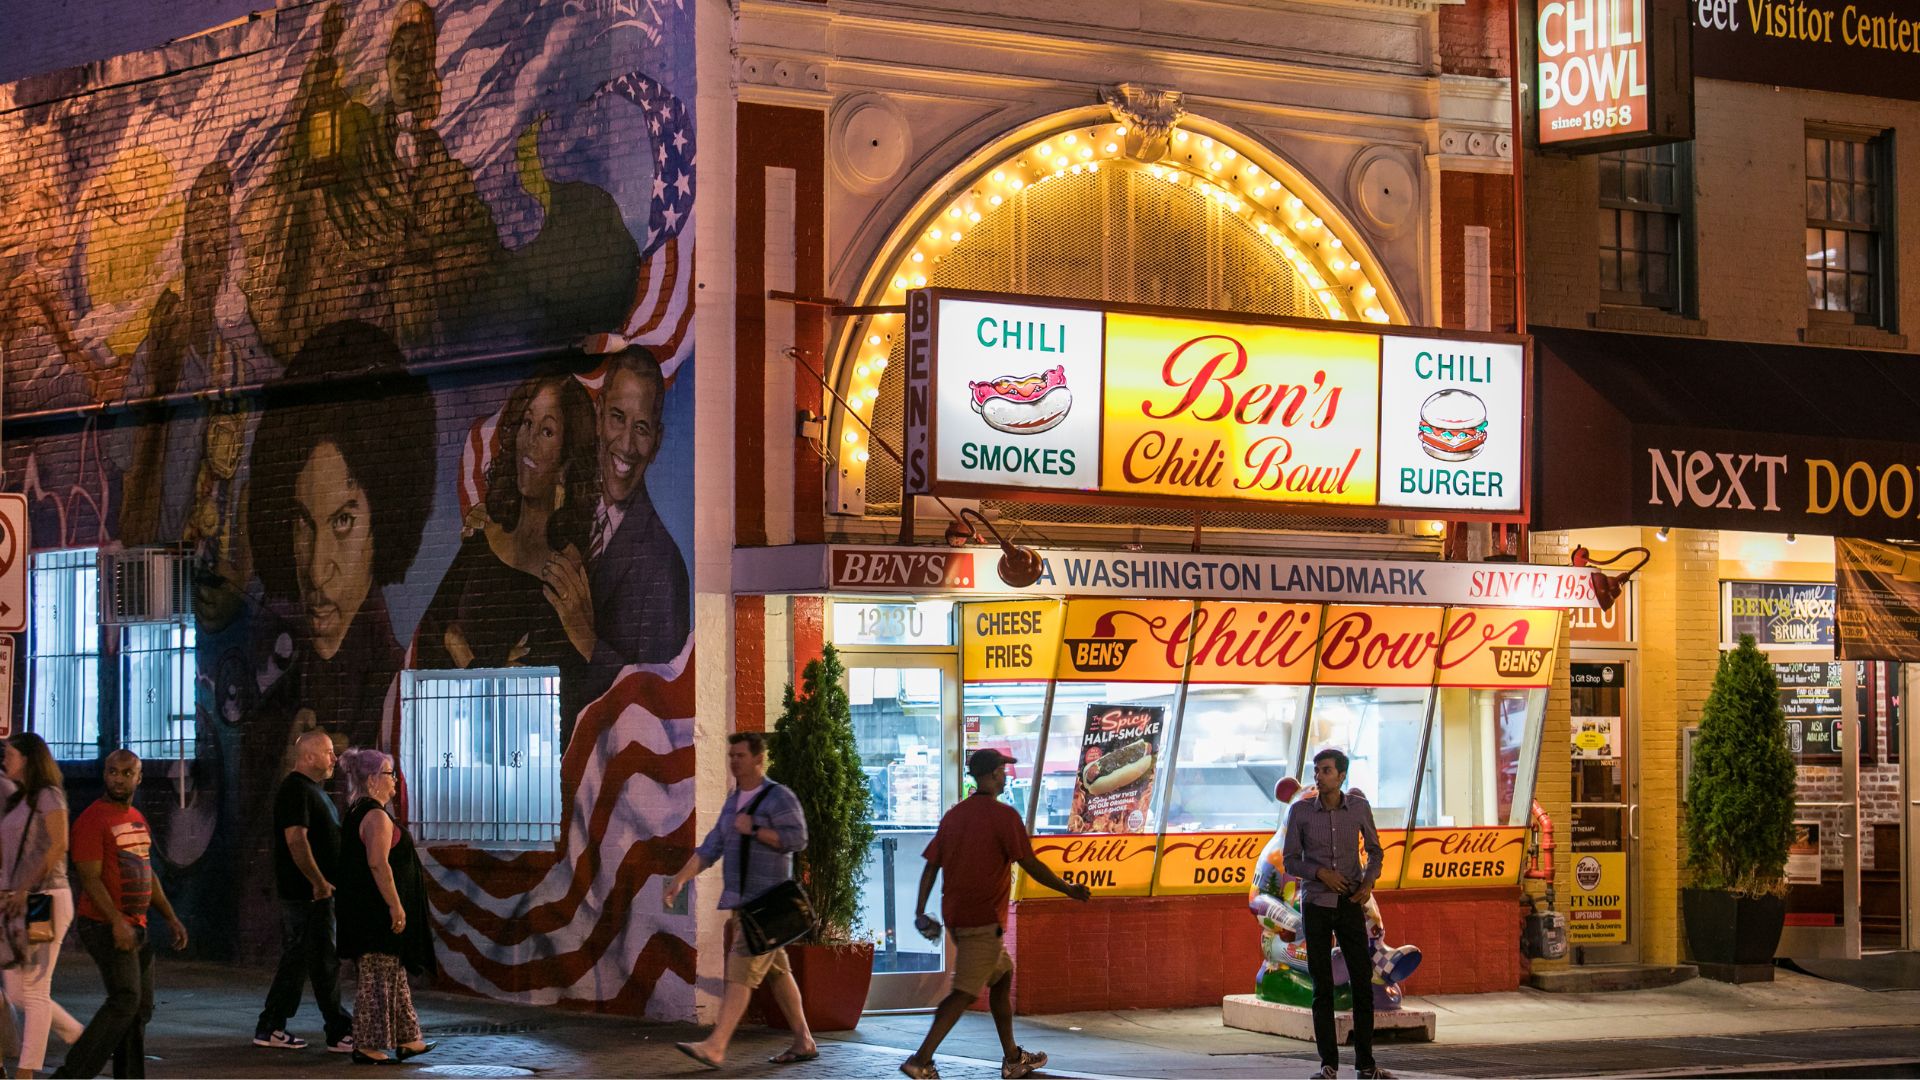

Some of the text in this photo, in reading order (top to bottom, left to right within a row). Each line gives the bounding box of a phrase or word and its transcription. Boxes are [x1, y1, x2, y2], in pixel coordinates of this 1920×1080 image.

[1538, 0, 1642, 57] CHILI
[1692, 0, 1920, 53] eet Visitor Center
[1539, 49, 1646, 109] BOWL
[1552, 105, 1632, 131] since 1958
[977, 317, 1066, 353] CHILI
[1415, 350, 1492, 384] CHILI
[909, 292, 929, 490] BEN'S
[1141, 334, 1343, 430] Ben's
[961, 442, 1076, 476] SMOKES
[1122, 430, 1362, 495] Chili Bowl
[1400, 467, 1505, 497] BURGER
[1804, 459, 1920, 519] DOO
[1036, 560, 1056, 586] A
[1064, 557, 1260, 592] WASHINGTON
[1271, 564, 1427, 596] LANDMARK
[1469, 569, 1547, 599] SINCE
[1732, 597, 1791, 618] BEN'S
[976, 610, 1042, 637] CHEESE
[1775, 624, 1818, 640] BRUNCH
[1076, 607, 1541, 673] BEN'S Chili Bowl BEN'S
[985, 644, 1033, 668] FRIES
[1575, 674, 1585, 682] Gift
[1586, 674, 1600, 683] Shop
[1102, 710, 1152, 733] Spicy
[1084, 722, 1160, 746] HALF-SMOKE
[1110, 797, 1135, 806] ORIGINAL
[1122, 790, 1138, 798] TWIST
[1062, 839, 1128, 863] Chili
[1194, 837, 1259, 861] Chili
[1441, 832, 1499, 855] Chili
[1063, 870, 1117, 887] BOWL
[1193, 866, 1246, 884] DOGS
[1422, 860, 1505, 878] BURGERS
[1570, 895, 1620, 906] FT SHOP
[1575, 910, 1602, 919] UPSTAIRS
